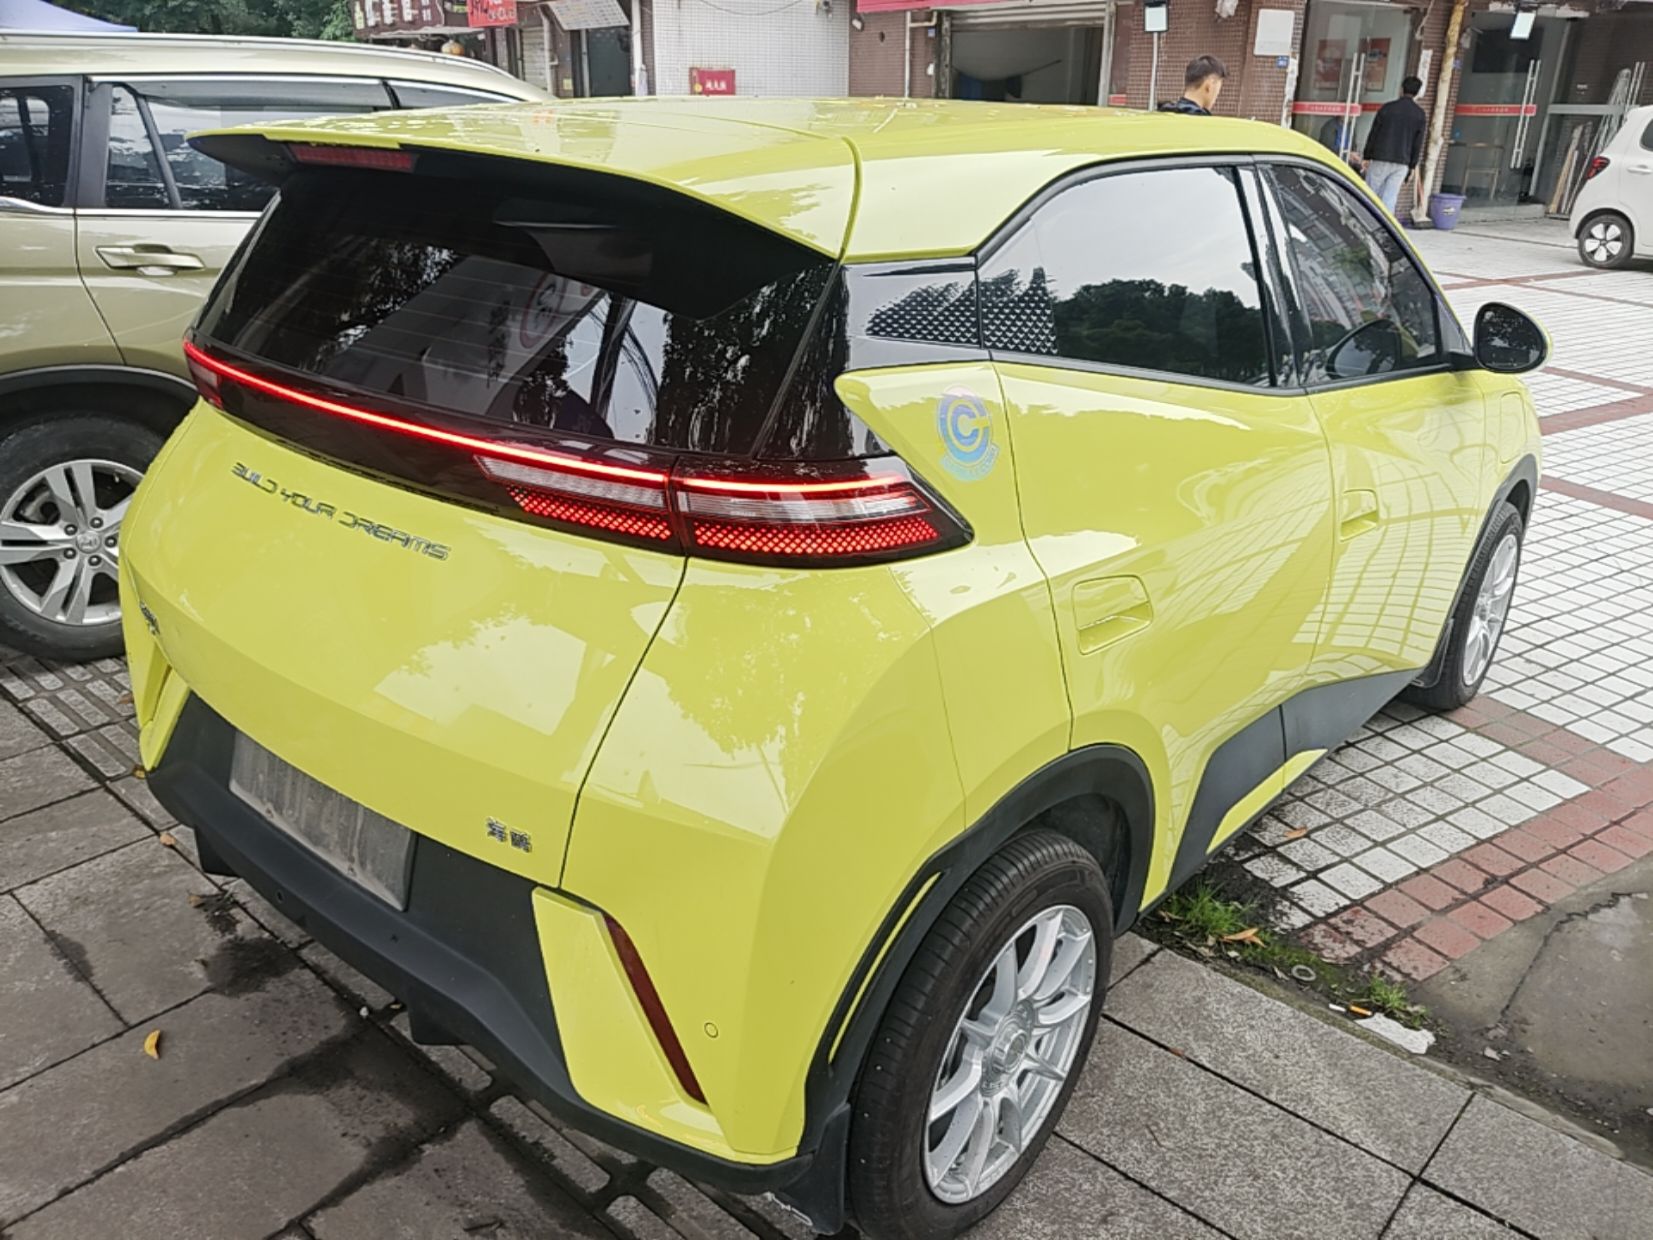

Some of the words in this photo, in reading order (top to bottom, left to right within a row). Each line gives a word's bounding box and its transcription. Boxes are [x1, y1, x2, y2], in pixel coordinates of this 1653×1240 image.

[231, 461, 279, 495] BUILD
[280, 487, 337, 520] YOUR
[338, 510, 452, 562] DREAMS
